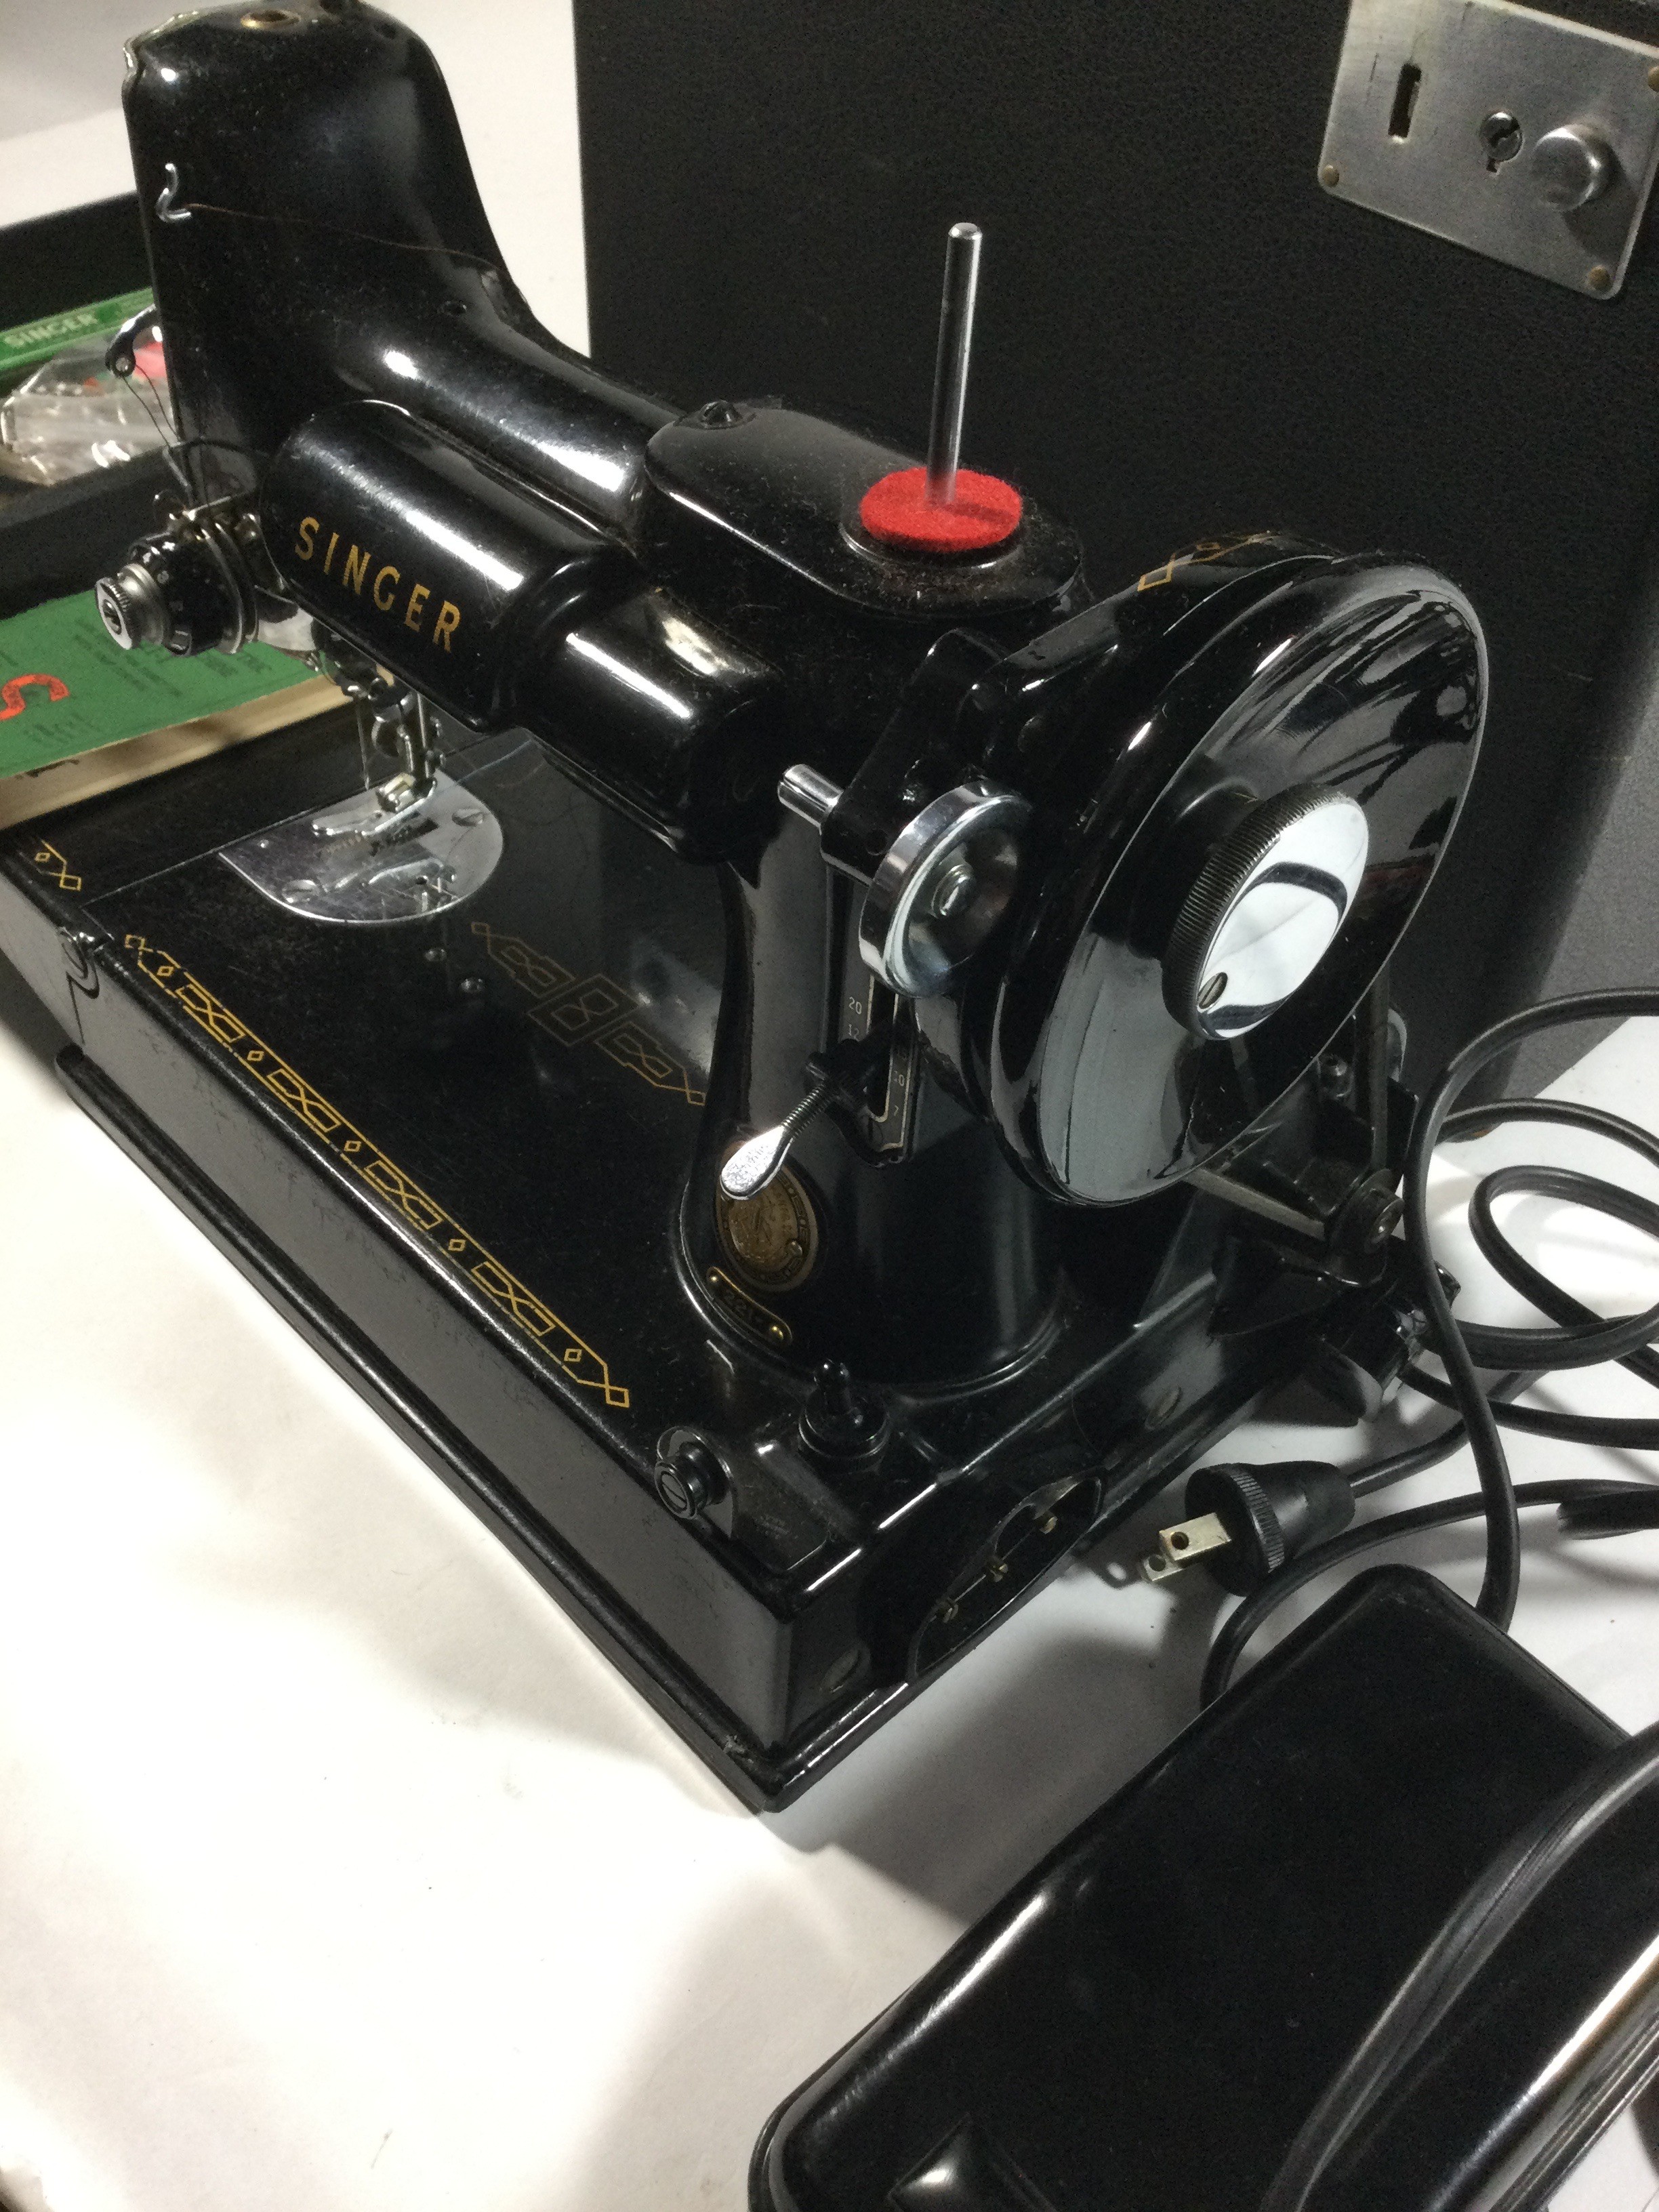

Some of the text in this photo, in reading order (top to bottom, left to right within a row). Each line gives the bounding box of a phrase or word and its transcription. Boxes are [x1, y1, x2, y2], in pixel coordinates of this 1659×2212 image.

[4, 314, 98, 347] SINGER
[295, 516, 461, 653] SINGER
[848, 996, 863, 1015] 20
[848, 1023, 860, 1042] 12
